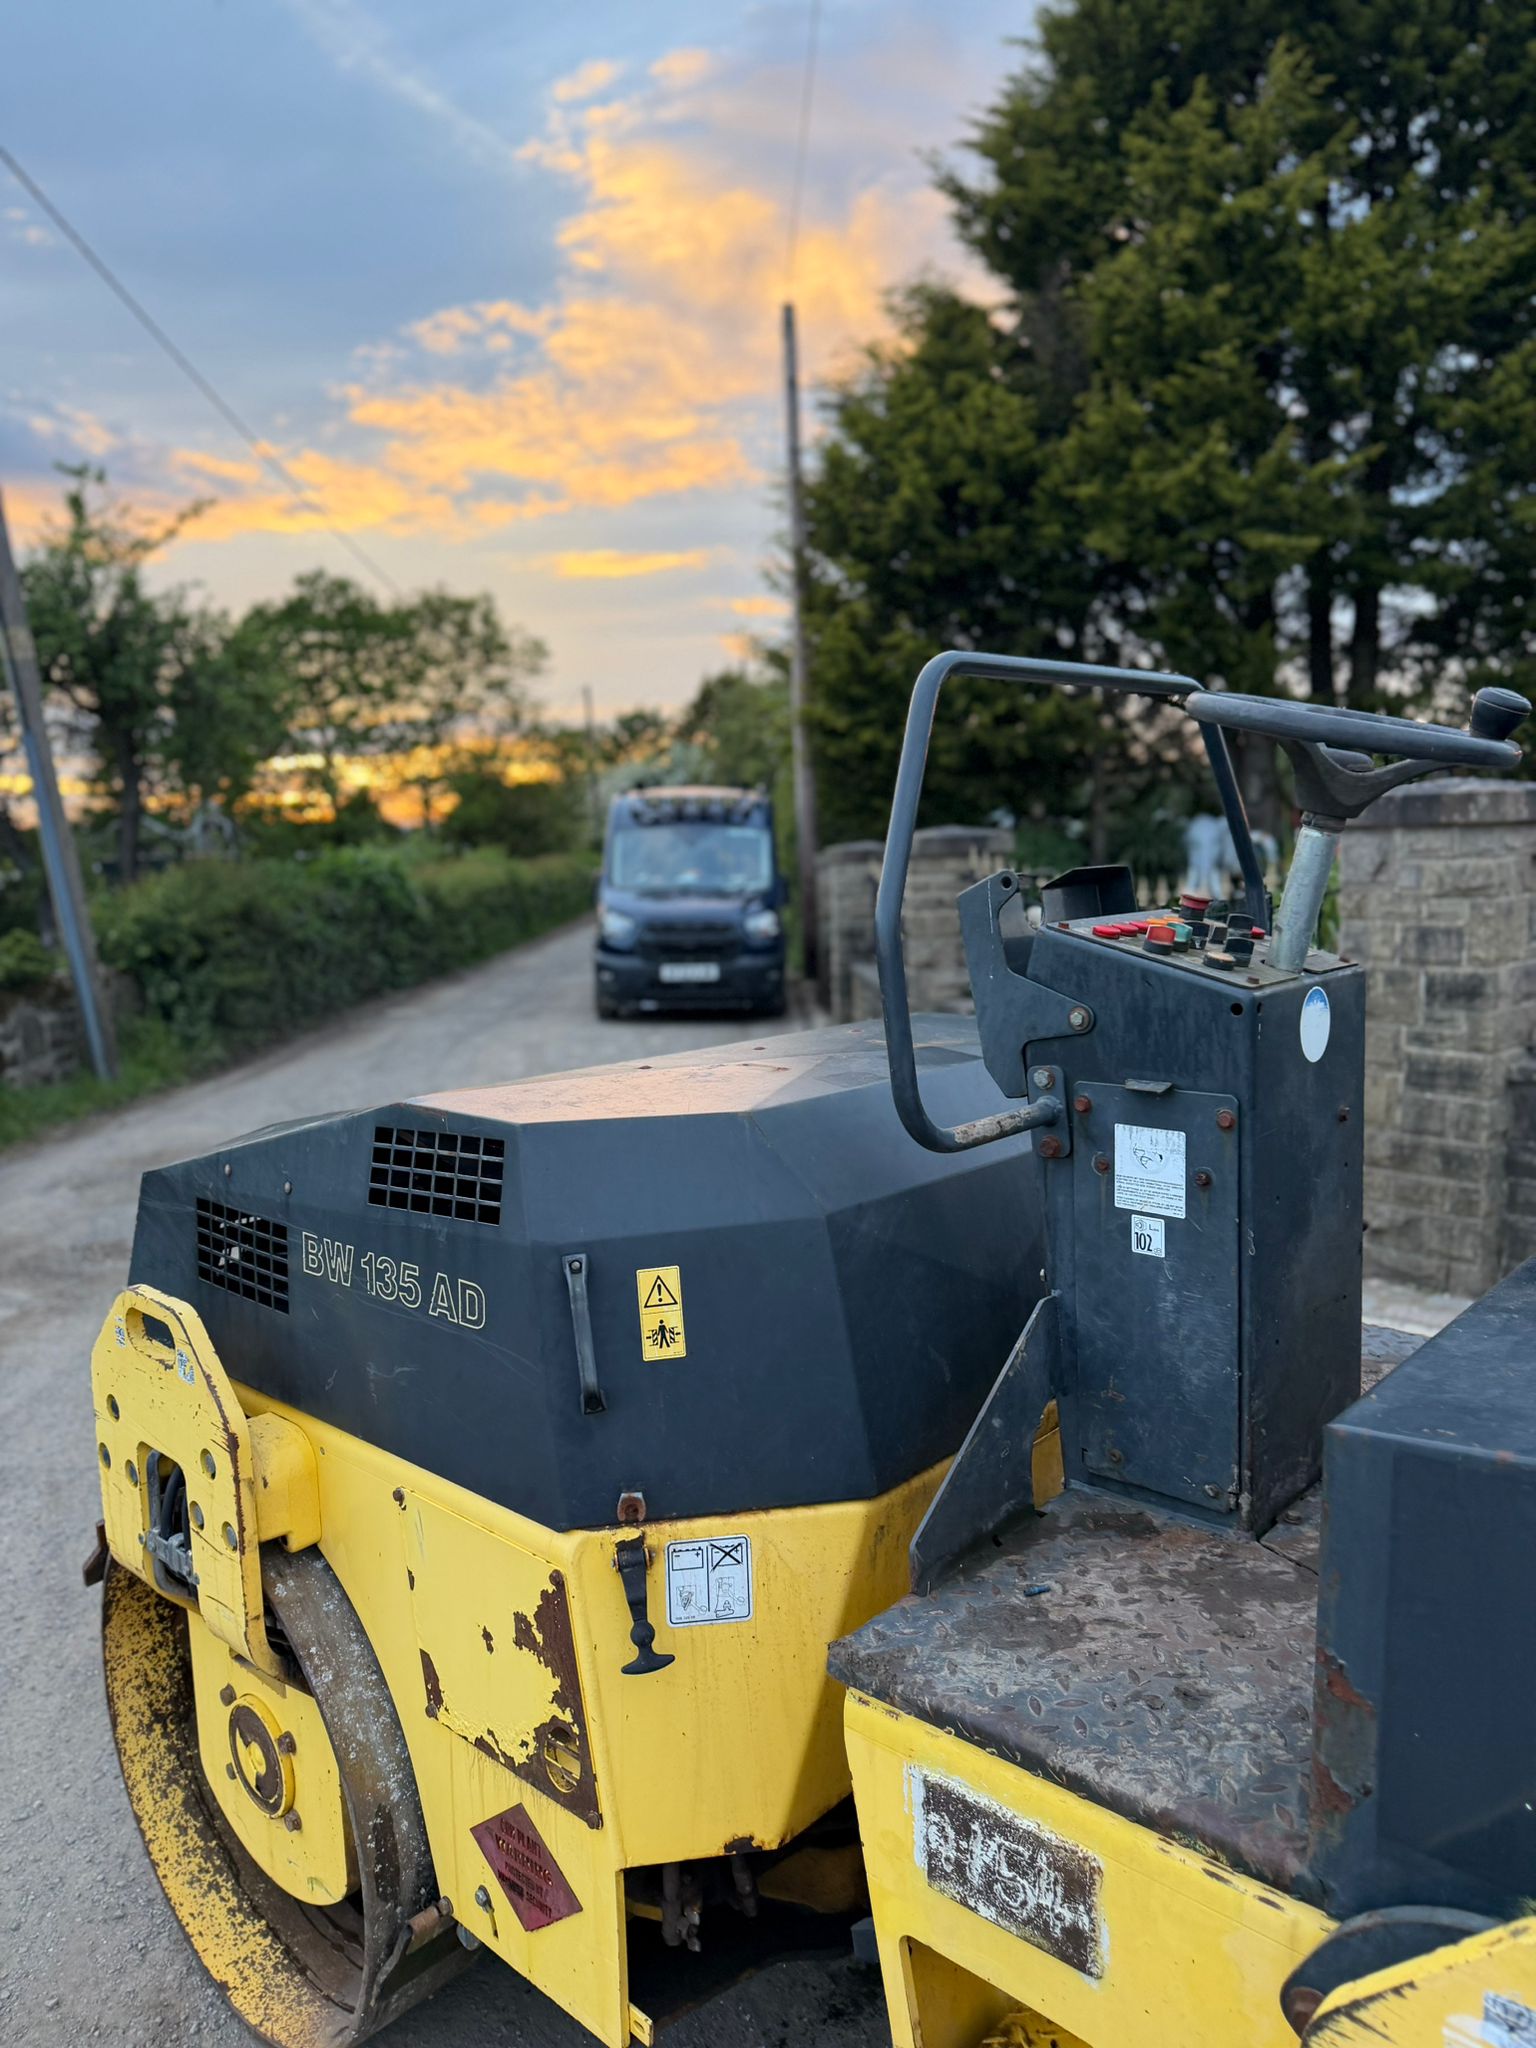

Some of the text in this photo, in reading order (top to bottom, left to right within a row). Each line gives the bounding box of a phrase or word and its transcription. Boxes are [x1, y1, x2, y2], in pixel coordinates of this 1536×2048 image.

[1134, 1231, 1153, 1252] 102
[302, 1231, 486, 1330] BW 135 AD
[495, 1833, 553, 1887] WARNING
